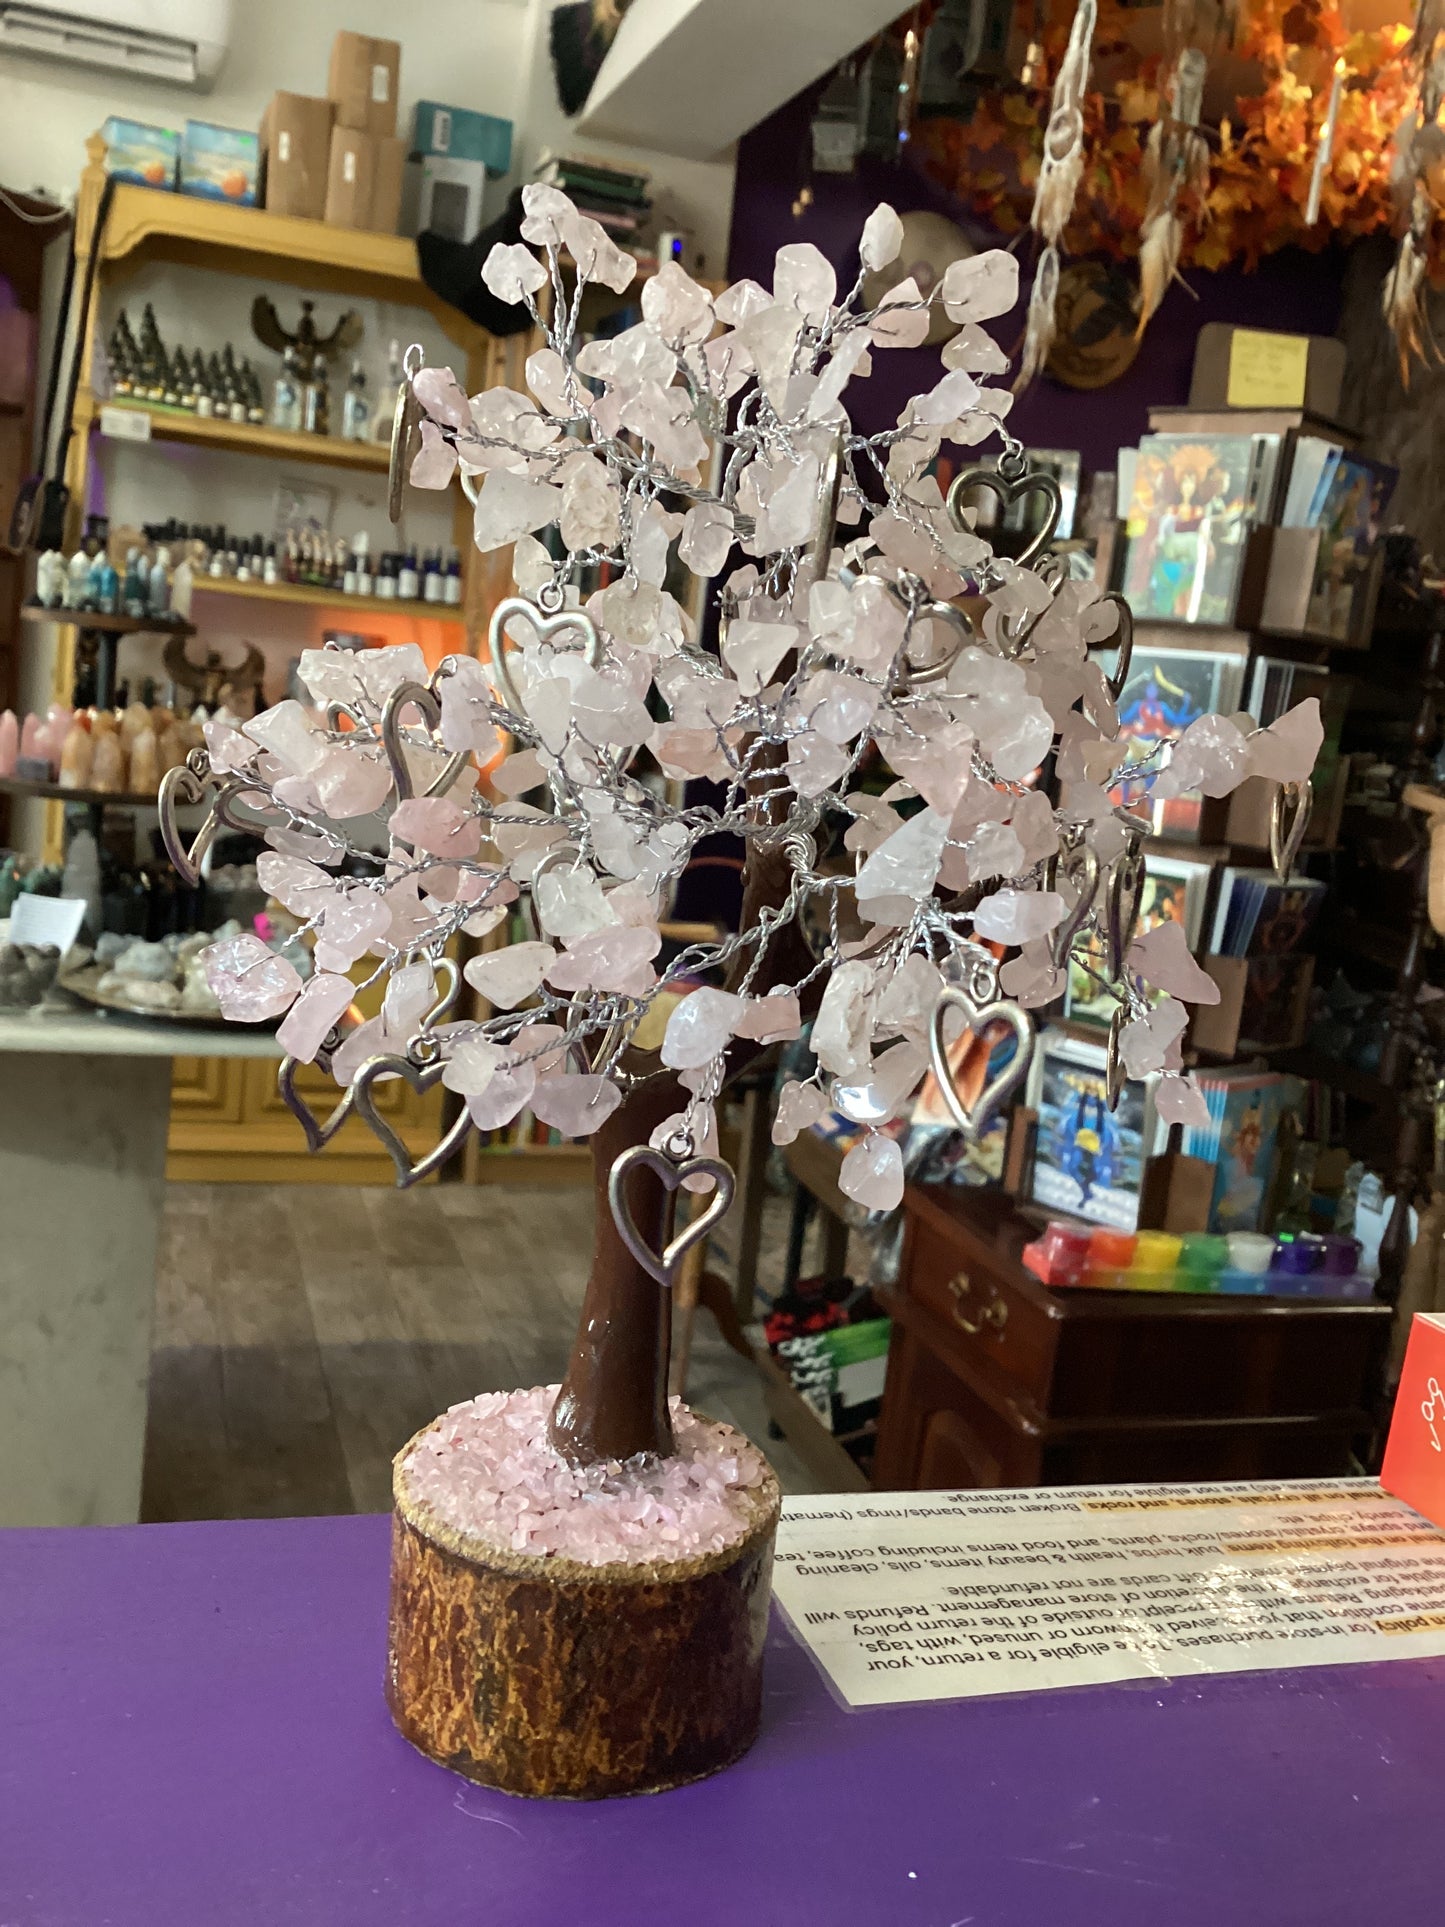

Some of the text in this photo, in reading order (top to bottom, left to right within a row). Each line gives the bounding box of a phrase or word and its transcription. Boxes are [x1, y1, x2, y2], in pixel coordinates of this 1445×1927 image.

[1054, 1490, 1104, 1502] return
[1108, 1490, 1132, 1498] for
[1133, 1486, 1191, 1498] eligible
[1192, 1486, 1221, 1495] not
[1222, 1485, 1248, 1494] are
[941, 1492, 1030, 1504] exchange.
[1032, 1492, 1052, 1501] or
[1170, 1496, 1231, 1508] stones,
[1302, 1494, 1322, 1502] all
[968, 1506, 1016, 1515] stone
[1019, 1502, 1082, 1514] Broken
[1137, 1500, 1170, 1510] and
[856, 1506, 966, 1519] bands/rings
[1304, 1512, 1354, 1523] chips,
[1403, 1522, 1435, 1532] and
[1021, 1540, 1066, 1552] food
[1067, 1538, 1100, 1549] and
[1103, 1534, 1162, 1548] plants,
[1276, 1538, 1356, 1551] following
[1356, 1538, 1384, 1546] the
[1384, 1536, 1407, 1544] on
[806, 1547, 874, 1561] coffee,
[878, 1544, 964, 1558] including
[966, 1543, 1020, 1555] items
[1126, 1548, 1184, 1560] herbs,
[1186, 1545, 1224, 1557] bulk
[987, 1554, 1051, 1568] beauty
[1052, 1554, 1067, 1564] &
[1068, 1550, 1126, 1564] health
[795, 1562, 878, 1578] cleaning
[881, 1559, 921, 1573] oils,
[922, 1558, 984, 1571] items,
[1358, 1558, 1420, 1573] original
[1087, 1577, 1115, 1590] are
[1119, 1574, 1171, 1588] cards
[1172, 1571, 1208, 1584] Gift
[1288, 1576, 1370, 1590] exchange
[1372, 1574, 1400, 1584] for
[942, 1580, 1048, 1598] refundable.
[1052, 1580, 1083, 1592] not
[1234, 1583, 1266, 1594] the
[932, 1596, 1066, 1613] management.
[1068, 1593, 1116, 1605] store
[1120, 1592, 1140, 1604] of
[1293, 1592, 1362, 1606] Returns
[803, 1611, 840, 1624] will
[844, 1605, 929, 1622] Refunds
[1042, 1608, 1113, 1624] outside
[1247, 1612, 1284, 1624] you
[1284, 1610, 1322, 1623] that
[1322, 1604, 1403, 1620] condition
[916, 1618, 977, 1632] return
[977, 1616, 1015, 1630] the
[1015, 1615, 1038, 1628] of
[1167, 1618, 1247, 1633] eived
[1375, 1616, 1430, 1632] policy
[852, 1620, 912, 1638] policy
[1048, 1630, 1067, 1641] or
[1071, 1624, 1144, 1638] nworn
[1276, 1626, 1345, 1640] in-store
[1348, 1623, 1376, 1635] for
[916, 1636, 962, 1650] with
[962, 1631, 1043, 1646] unused,
[1170, 1630, 1273, 1648] purchases.
[859, 1638, 913, 1653] tags,
[1040, 1641, 1110, 1660] eligible
[915, 1652, 984, 1667] return,
[988, 1651, 1002, 1661] a
[1007, 1650, 1037, 1662] for
[866, 1656, 914, 1672] your
